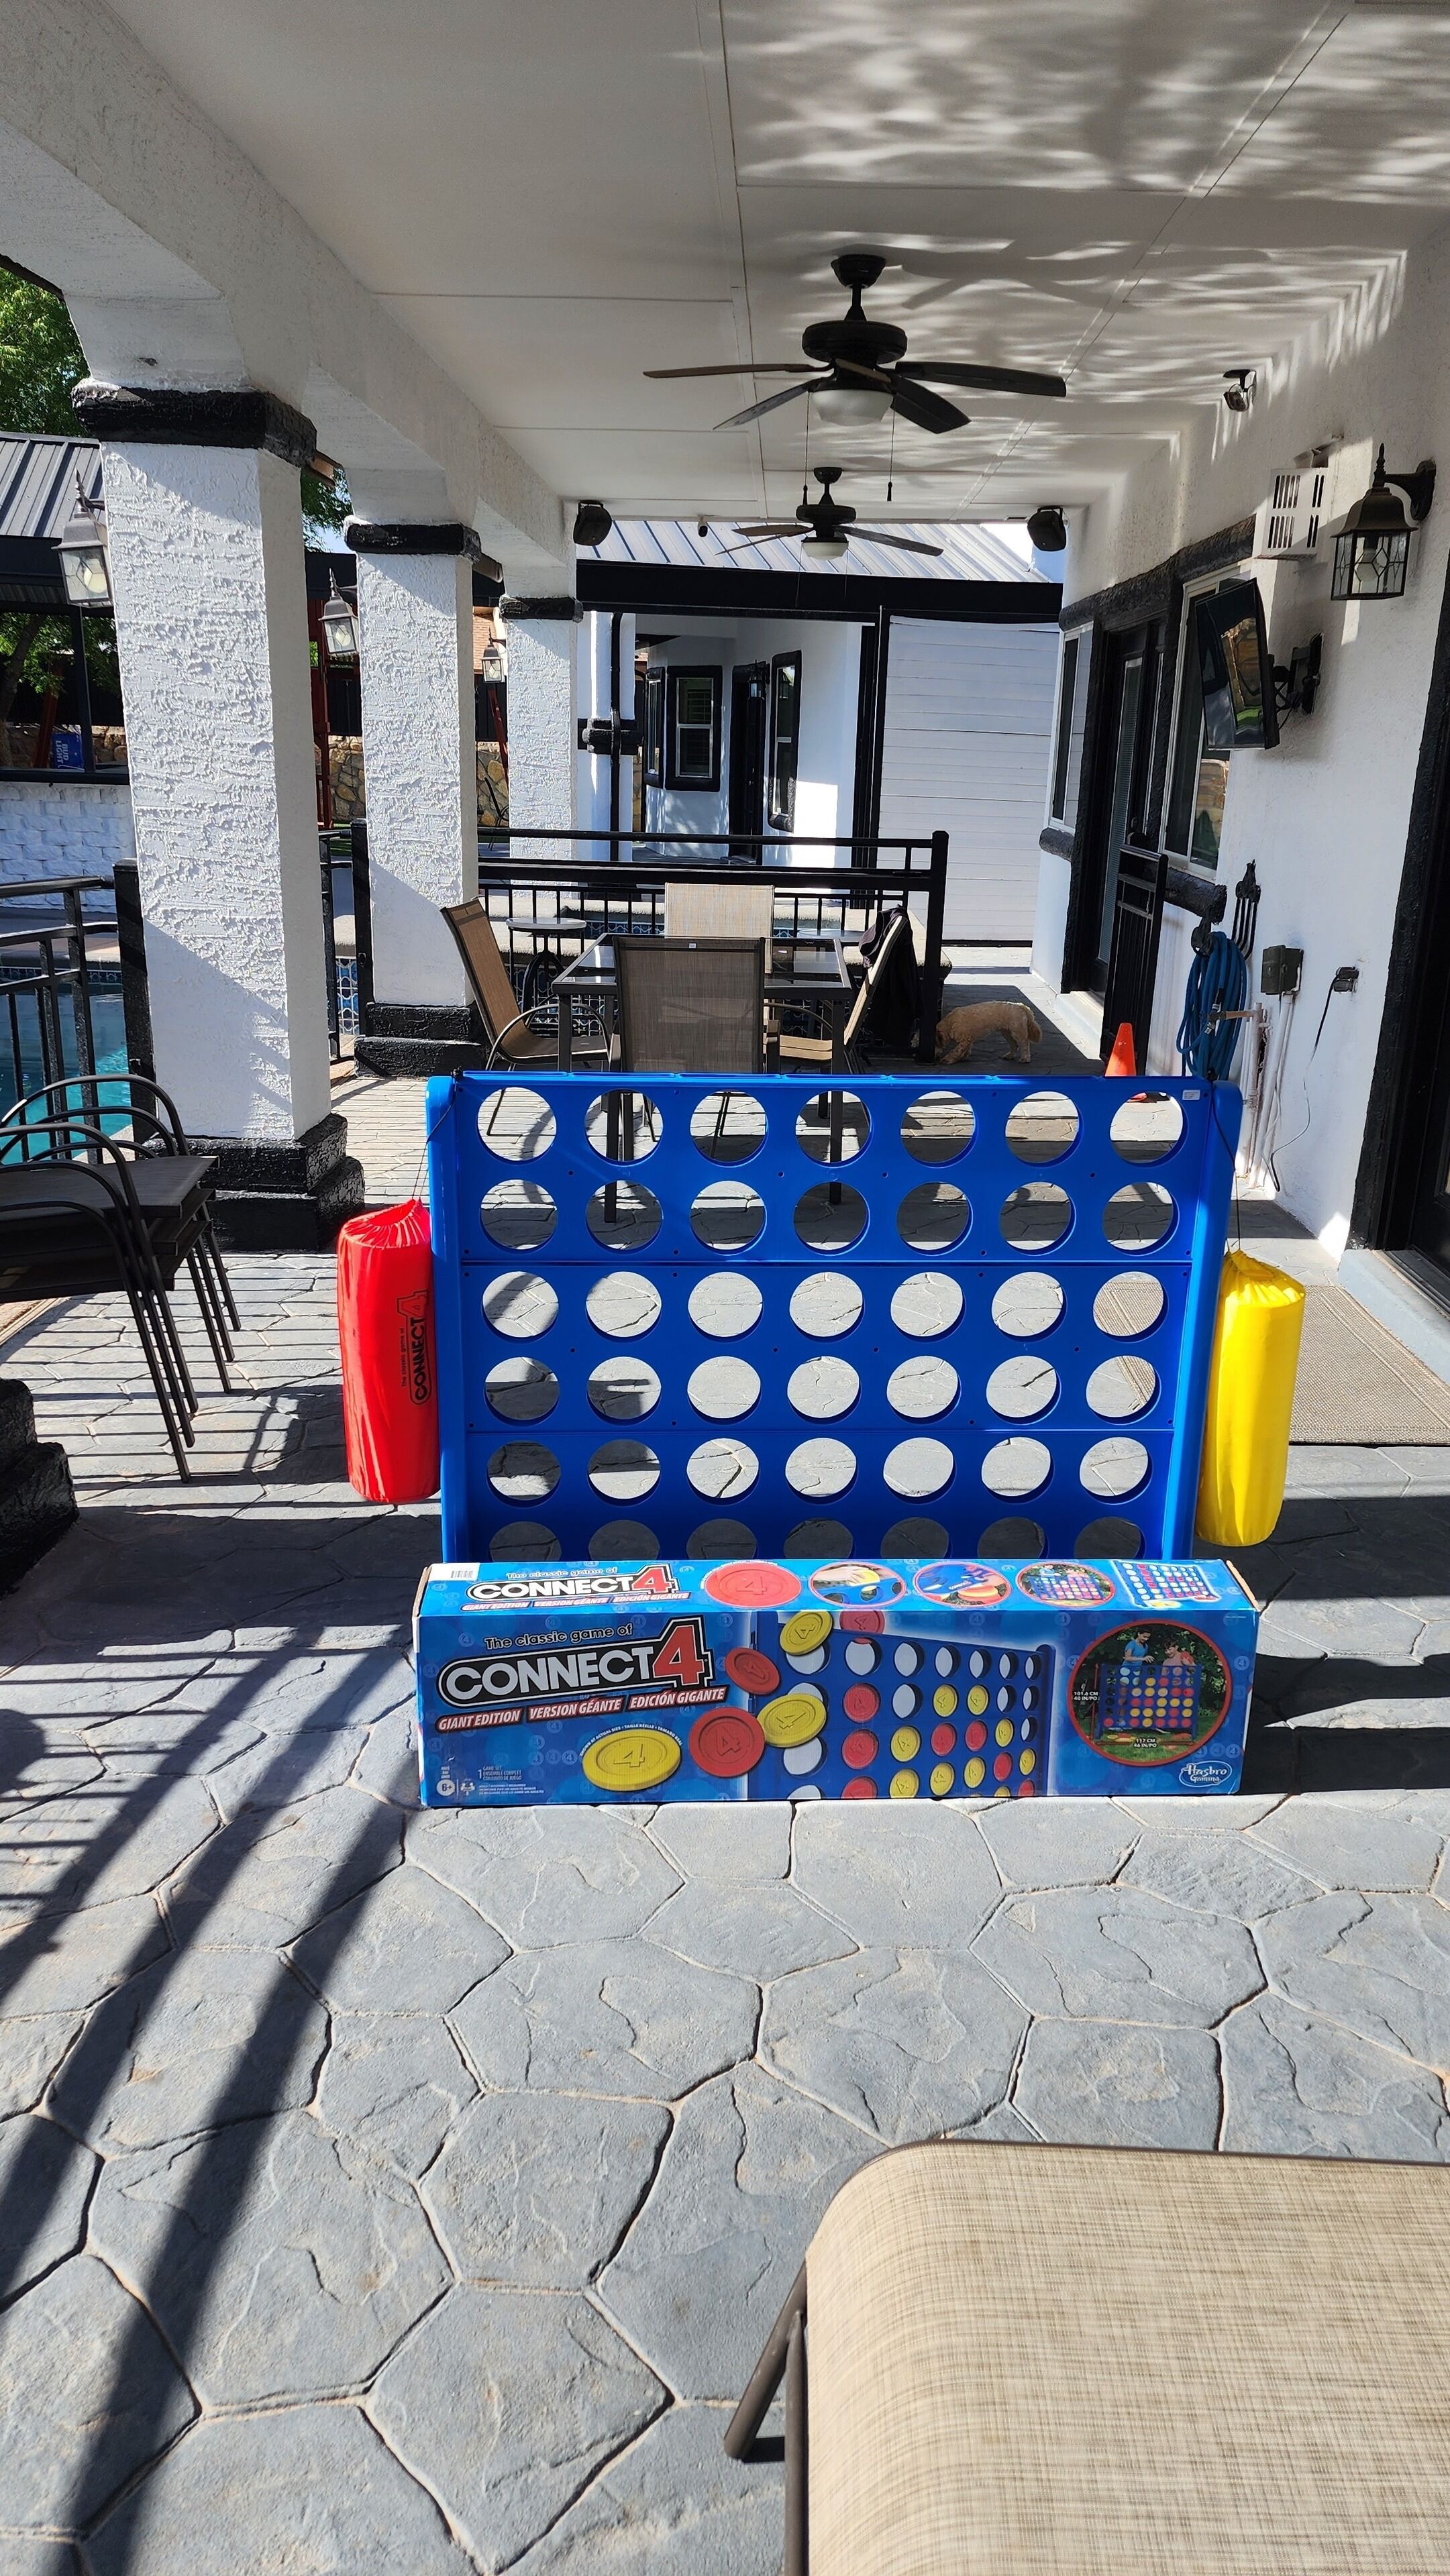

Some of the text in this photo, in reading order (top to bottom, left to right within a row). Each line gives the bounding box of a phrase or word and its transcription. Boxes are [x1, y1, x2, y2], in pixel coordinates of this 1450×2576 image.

[55, 740, 64, 764] LIGHT
[402, 1294, 428, 1401] CONNECT 4
[472, 1566, 672, 1600] CONNECT 4
[533, 1599, 574, 1607] VERSION
[484, 1622, 633, 1650] The classic game of
[446, 1624, 705, 1701] CONNECT 4
[438, 1686, 727, 1731] GIANT EDITION VERSION GÉANTE EDICIÓN GIGANTE
[1183, 1764, 1227, 1778] Hasbro
[1190, 1774, 1220, 1784] Gaming
[442, 1783, 454, 1792] 6+
